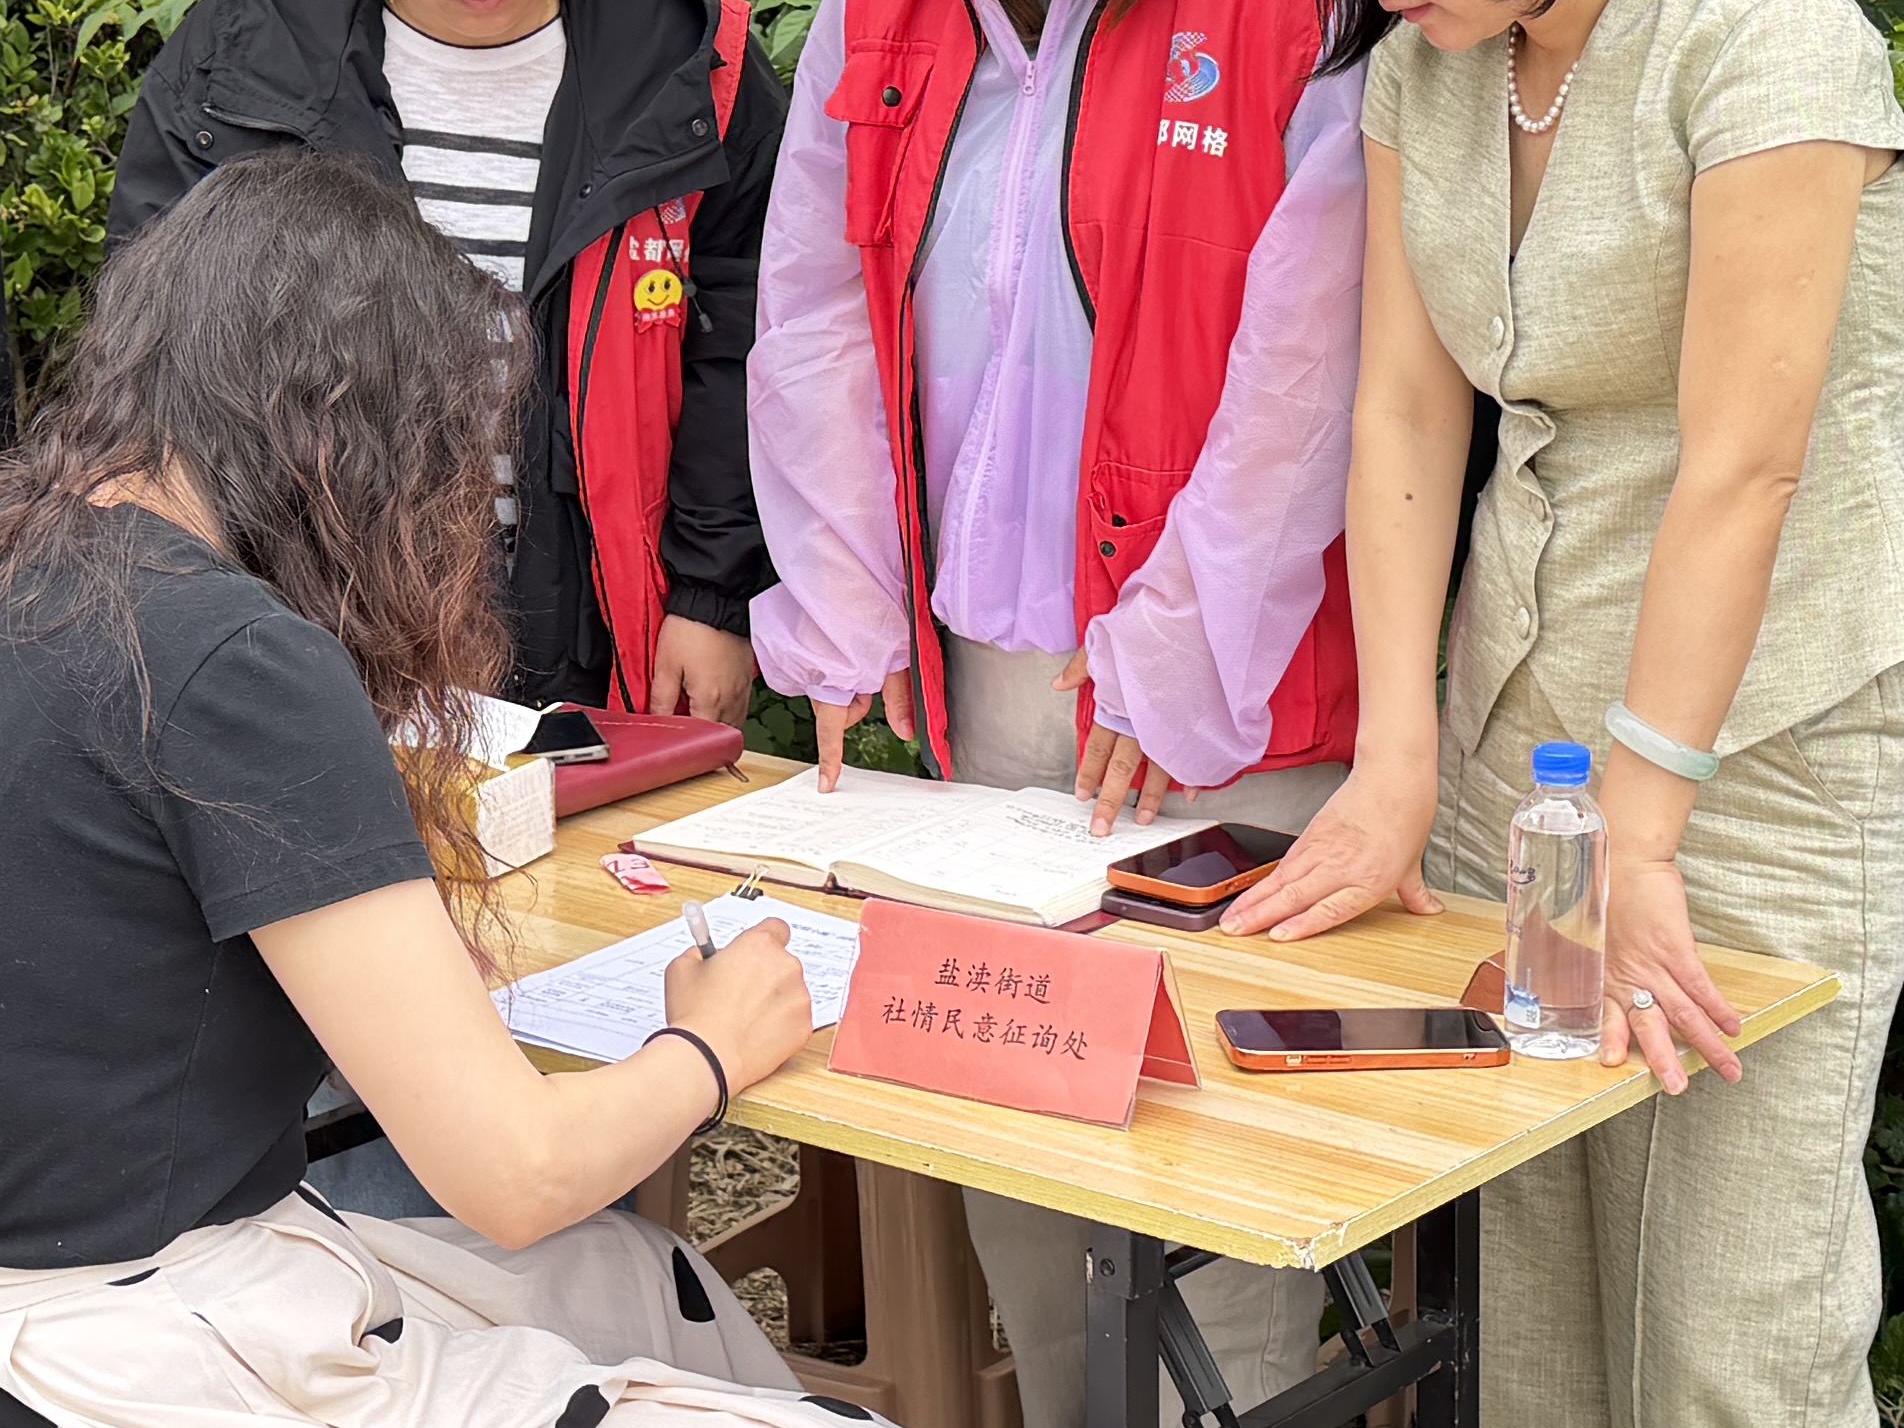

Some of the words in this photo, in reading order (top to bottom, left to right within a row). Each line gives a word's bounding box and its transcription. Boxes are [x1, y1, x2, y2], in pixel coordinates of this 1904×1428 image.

[934, 957, 1052, 1005] 盐渎街道
[881, 995, 1089, 1061] 社情民意征询处
